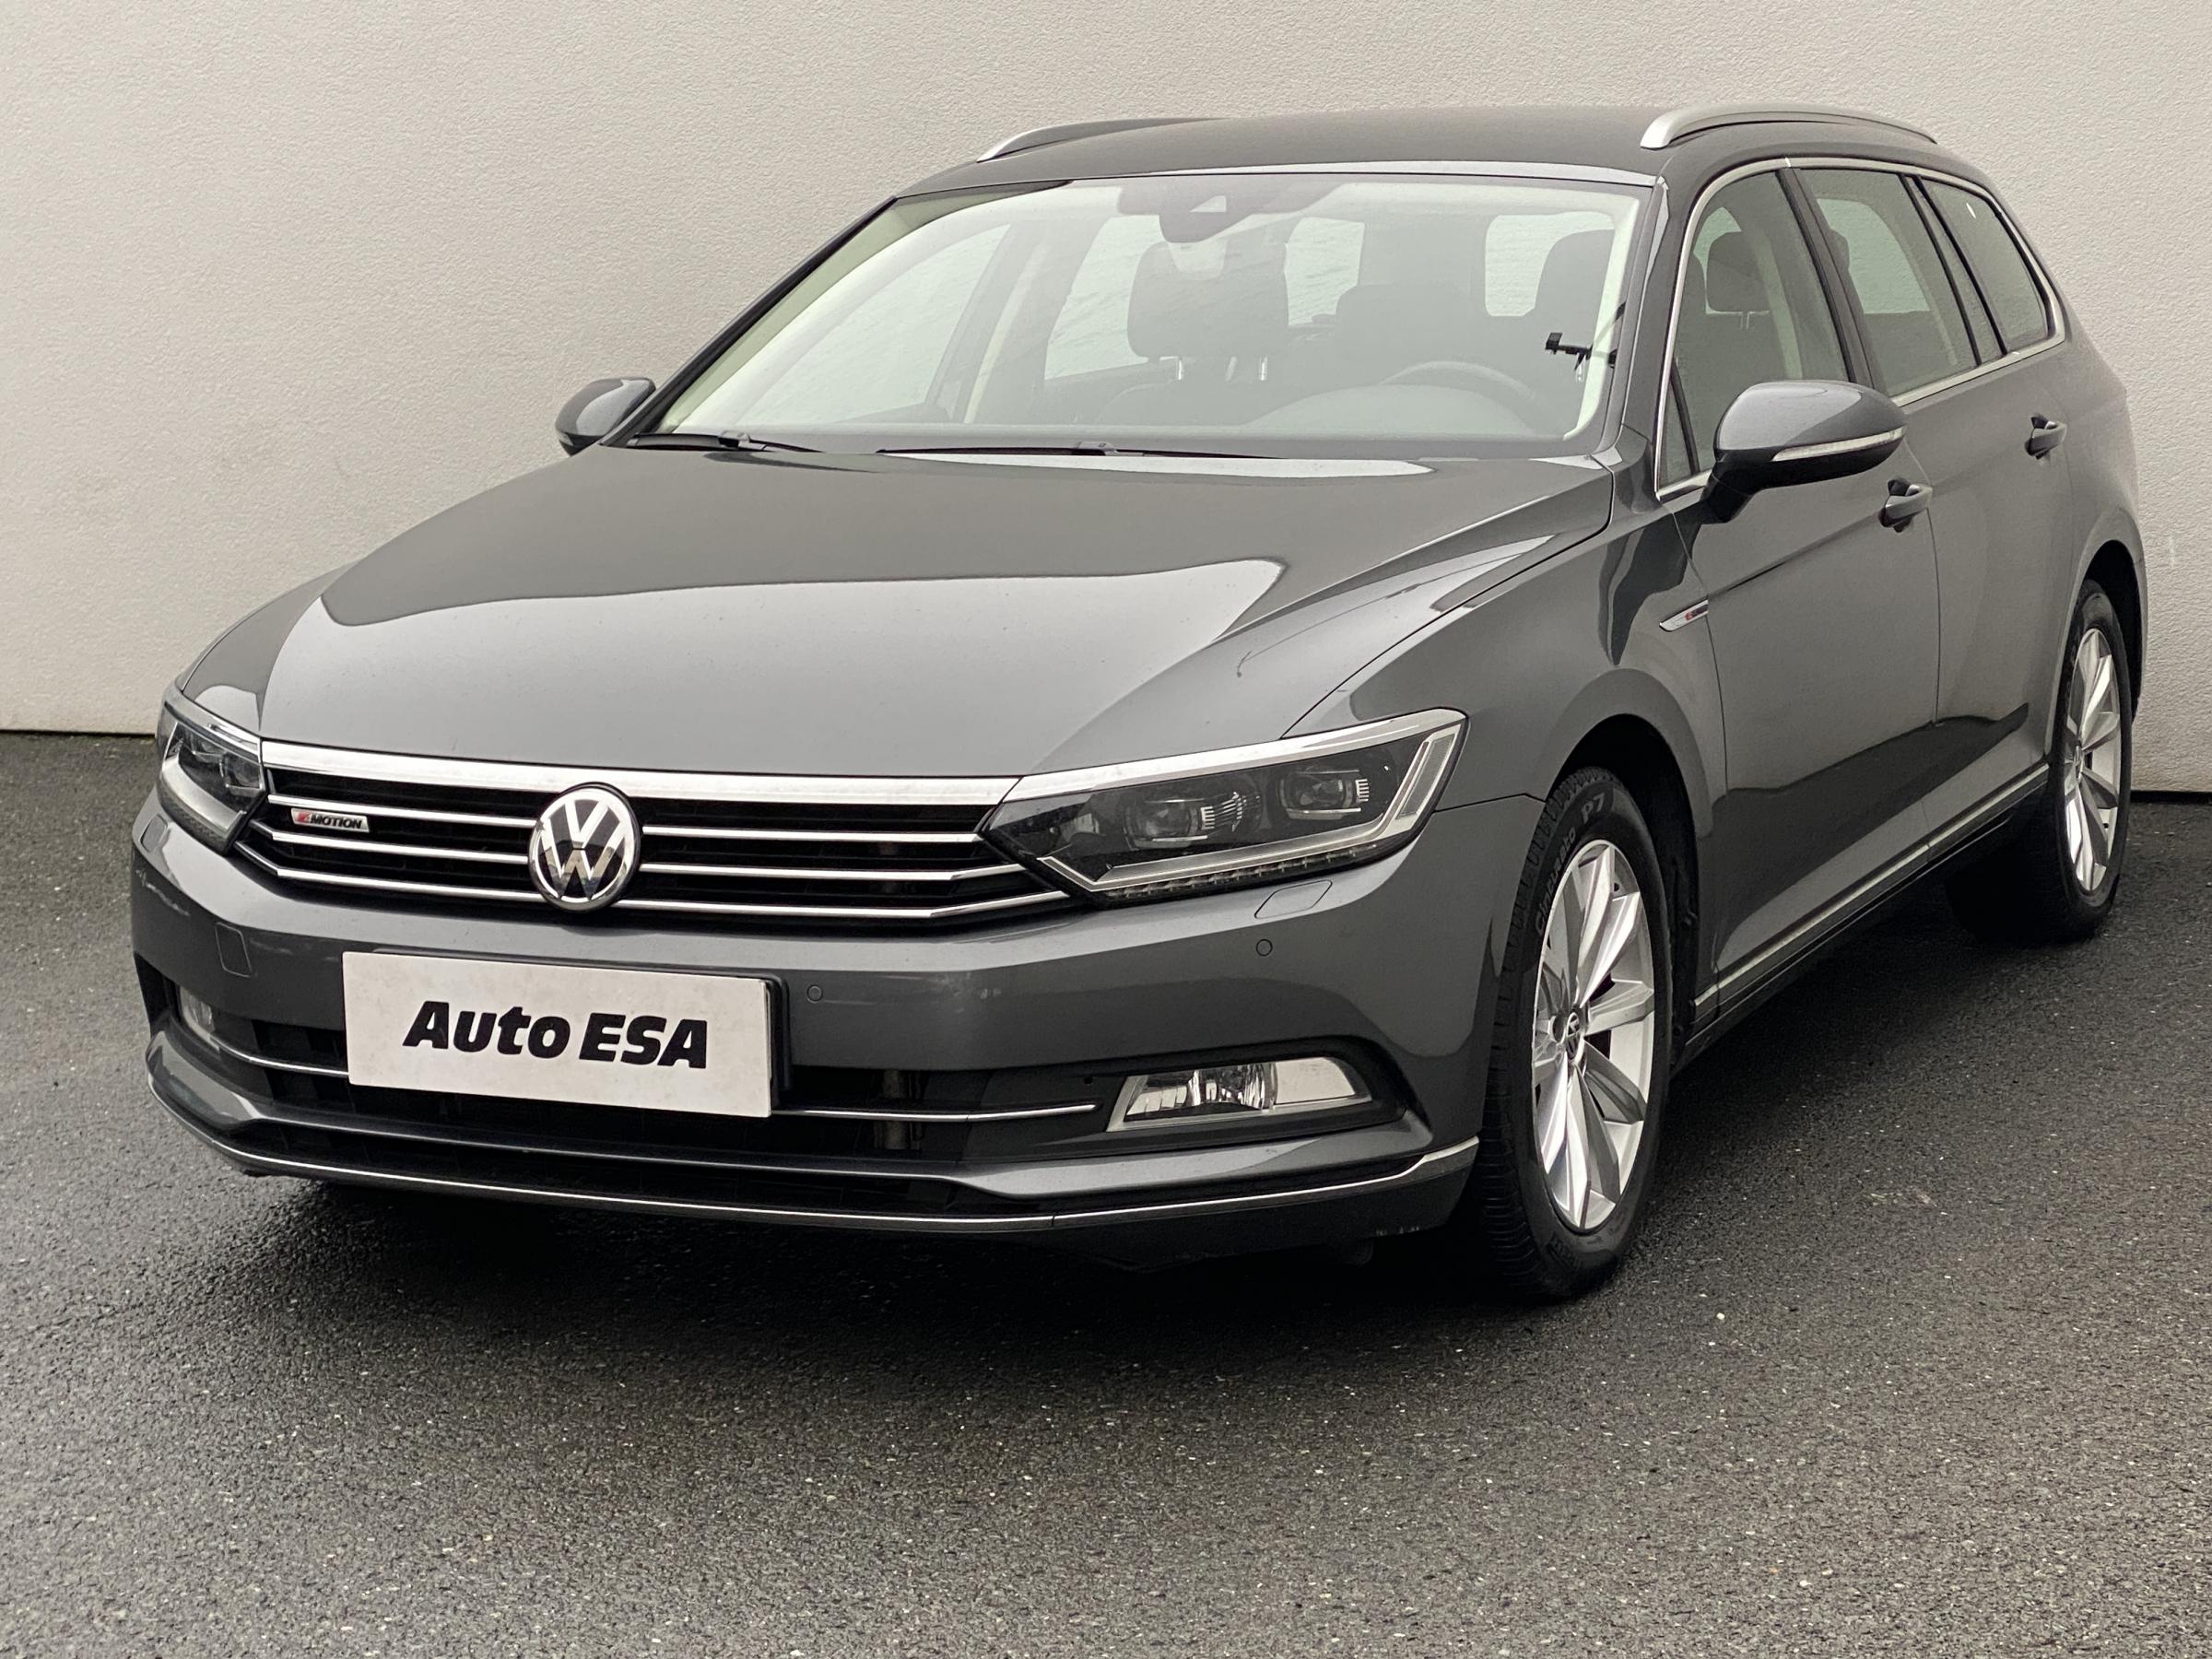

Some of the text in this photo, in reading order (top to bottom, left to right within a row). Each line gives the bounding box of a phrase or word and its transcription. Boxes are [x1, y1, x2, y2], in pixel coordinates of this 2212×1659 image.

[1582, 794, 1605, 824] P7
[402, 1000, 708, 1069] Auto ESA
